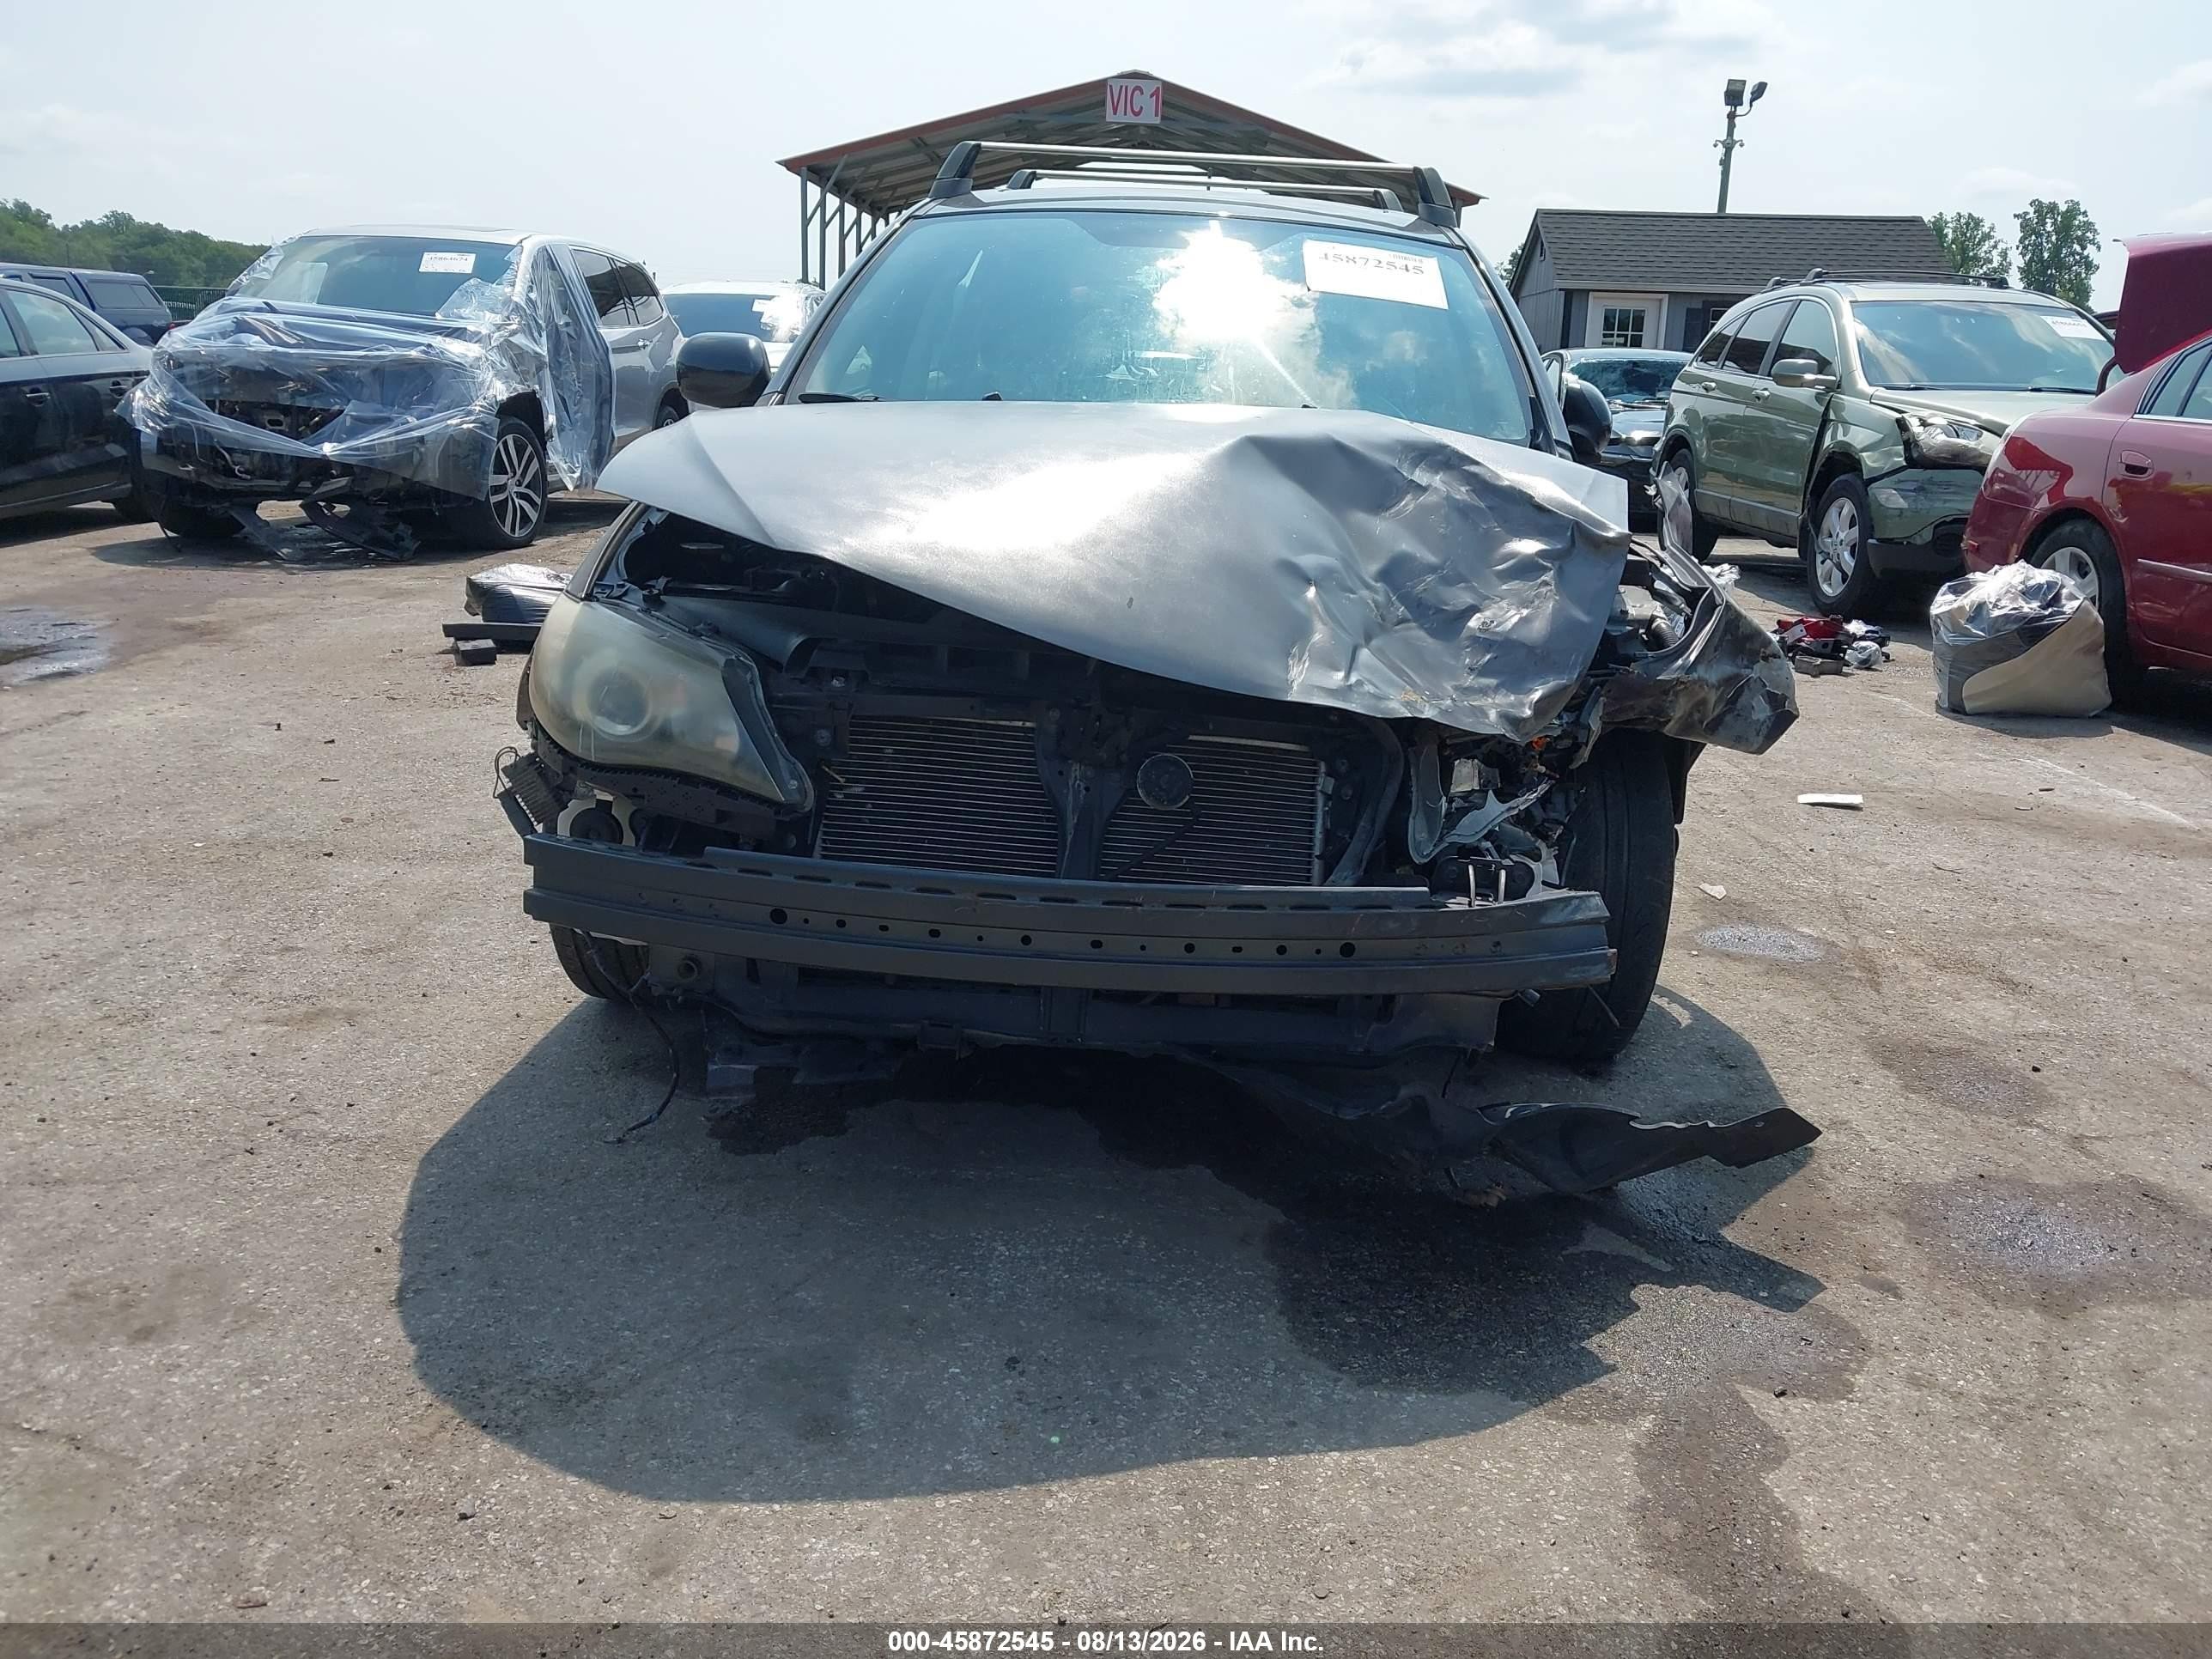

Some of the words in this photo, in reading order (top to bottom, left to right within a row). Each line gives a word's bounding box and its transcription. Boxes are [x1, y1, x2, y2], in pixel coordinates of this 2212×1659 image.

[1109, 84, 1144, 117] VIC
[1149, 86, 1161, 118] 1
[1318, 252, 1425, 276] 45872545
